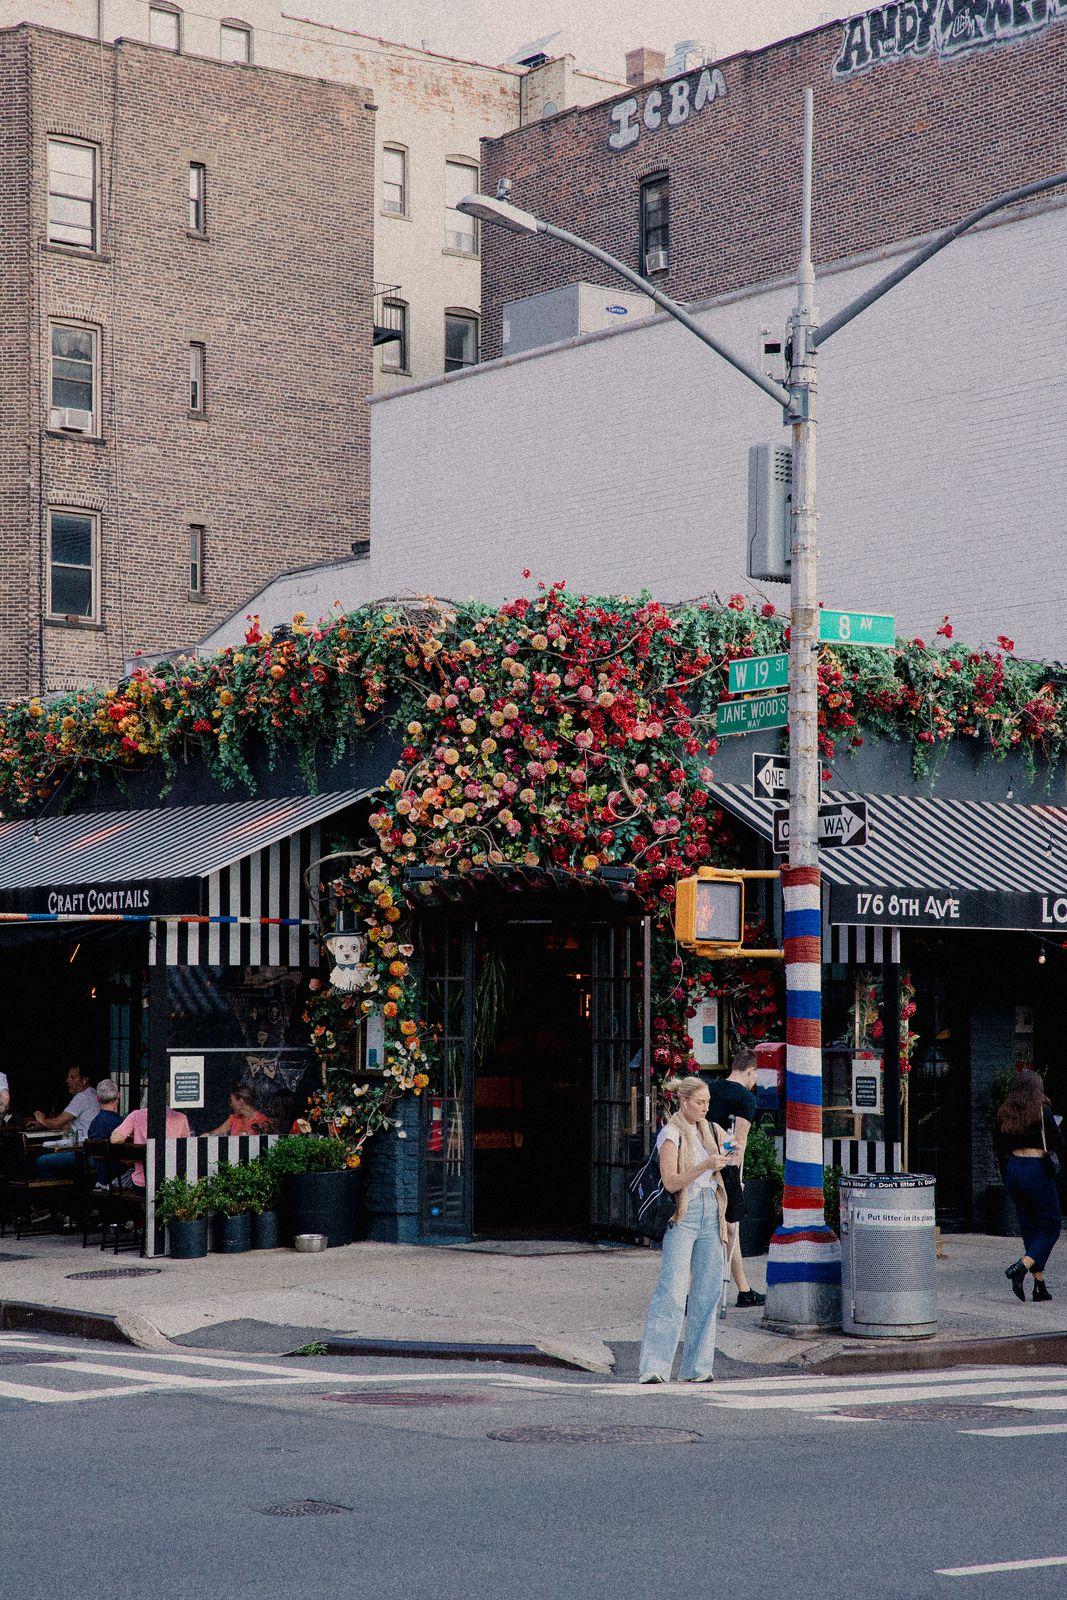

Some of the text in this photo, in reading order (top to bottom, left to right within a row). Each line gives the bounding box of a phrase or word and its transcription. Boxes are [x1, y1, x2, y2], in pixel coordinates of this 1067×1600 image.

[609, 68, 728, 151] ICBM
[838, 615, 872, 639] 8 AV
[735, 658, 785, 688] W 19 ST
[720, 698, 786, 724] JANE WOOD'S
[747, 719, 760, 729] WAY
[764, 771, 784, 787] ONE
[823, 816, 853, 835] WAY
[47, 889, 150, 914] CRAFT COCKTAILS
[856, 893, 960, 919] 176 8TH AVE
[867, 1213, 881, 1221] Put
[883, 1213, 902, 1221] litter
[903, 1213, 911, 1221] in
[911, 1214, 920, 1222] its
